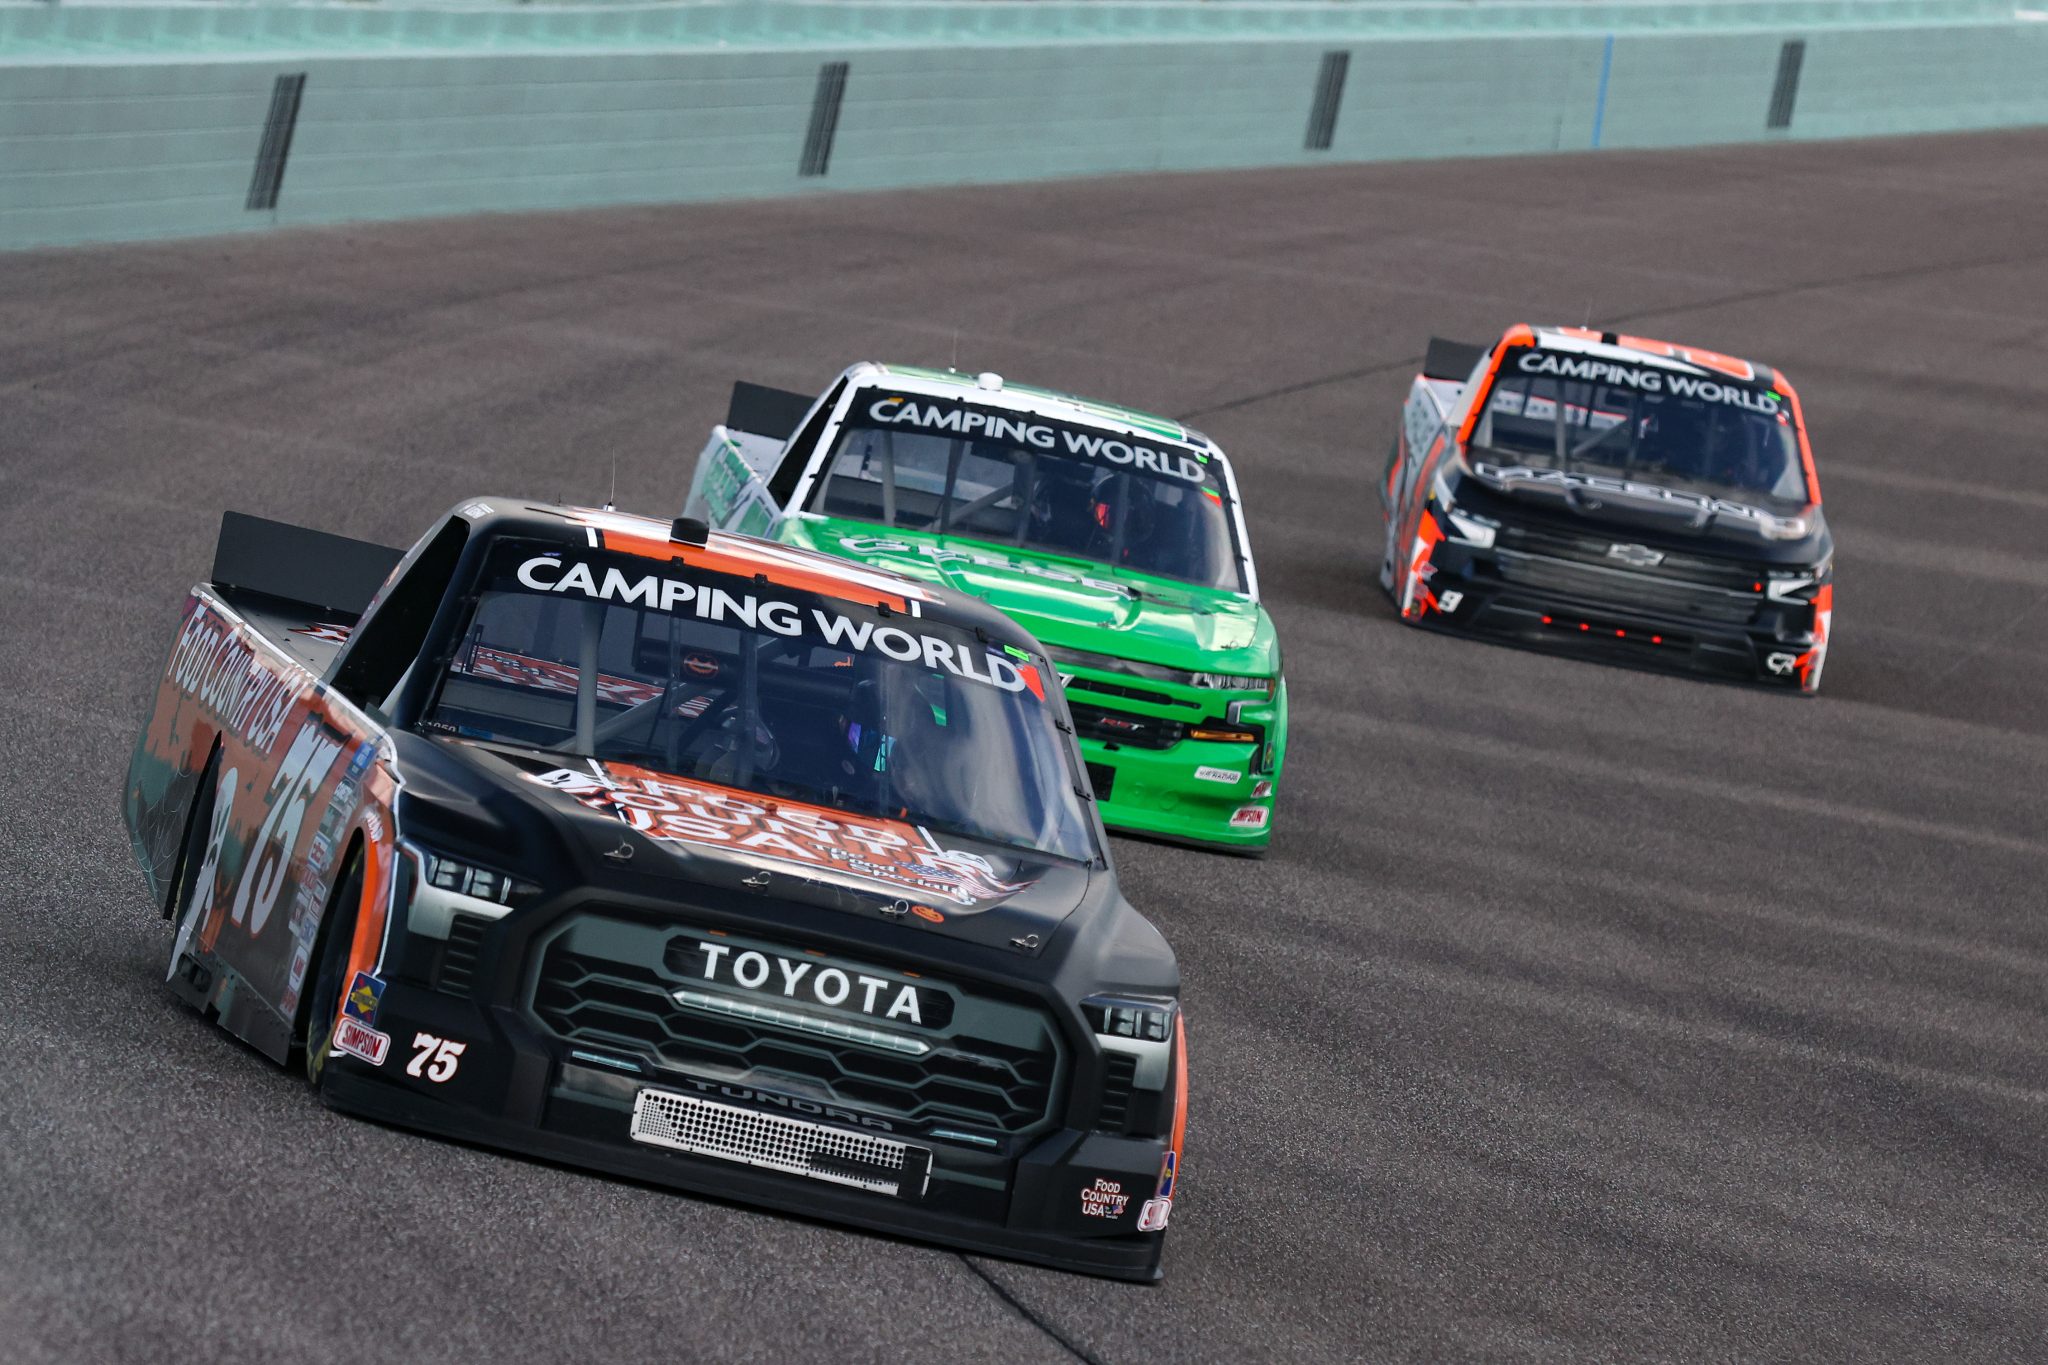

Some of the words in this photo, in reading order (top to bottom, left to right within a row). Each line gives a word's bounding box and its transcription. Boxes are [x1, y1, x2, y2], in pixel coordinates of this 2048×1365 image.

[1519, 352, 1662, 392] CAMPING
[1665, 373, 1779, 415] WORLD
[869, 397, 1057, 450] CAMPING
[1062, 429, 1206, 484] WORLD
[167, 602, 220, 694] FOOD
[516, 555, 803, 637] CAMPING
[812, 608, 1026, 693] WORLD
[639, 778, 909, 848] FOOD
[697, 940, 923, 1026] TOYOTA
[342, 1024, 383, 1059] SIMPSON
[406, 1031, 467, 1083] 75
[685, 1078, 894, 1132] TUNDRA
[1080, 1187, 1130, 1206] COUNTRY
[1082, 1201, 1105, 1217] USA
[1094, 1177, 1121, 1193] FOOD
